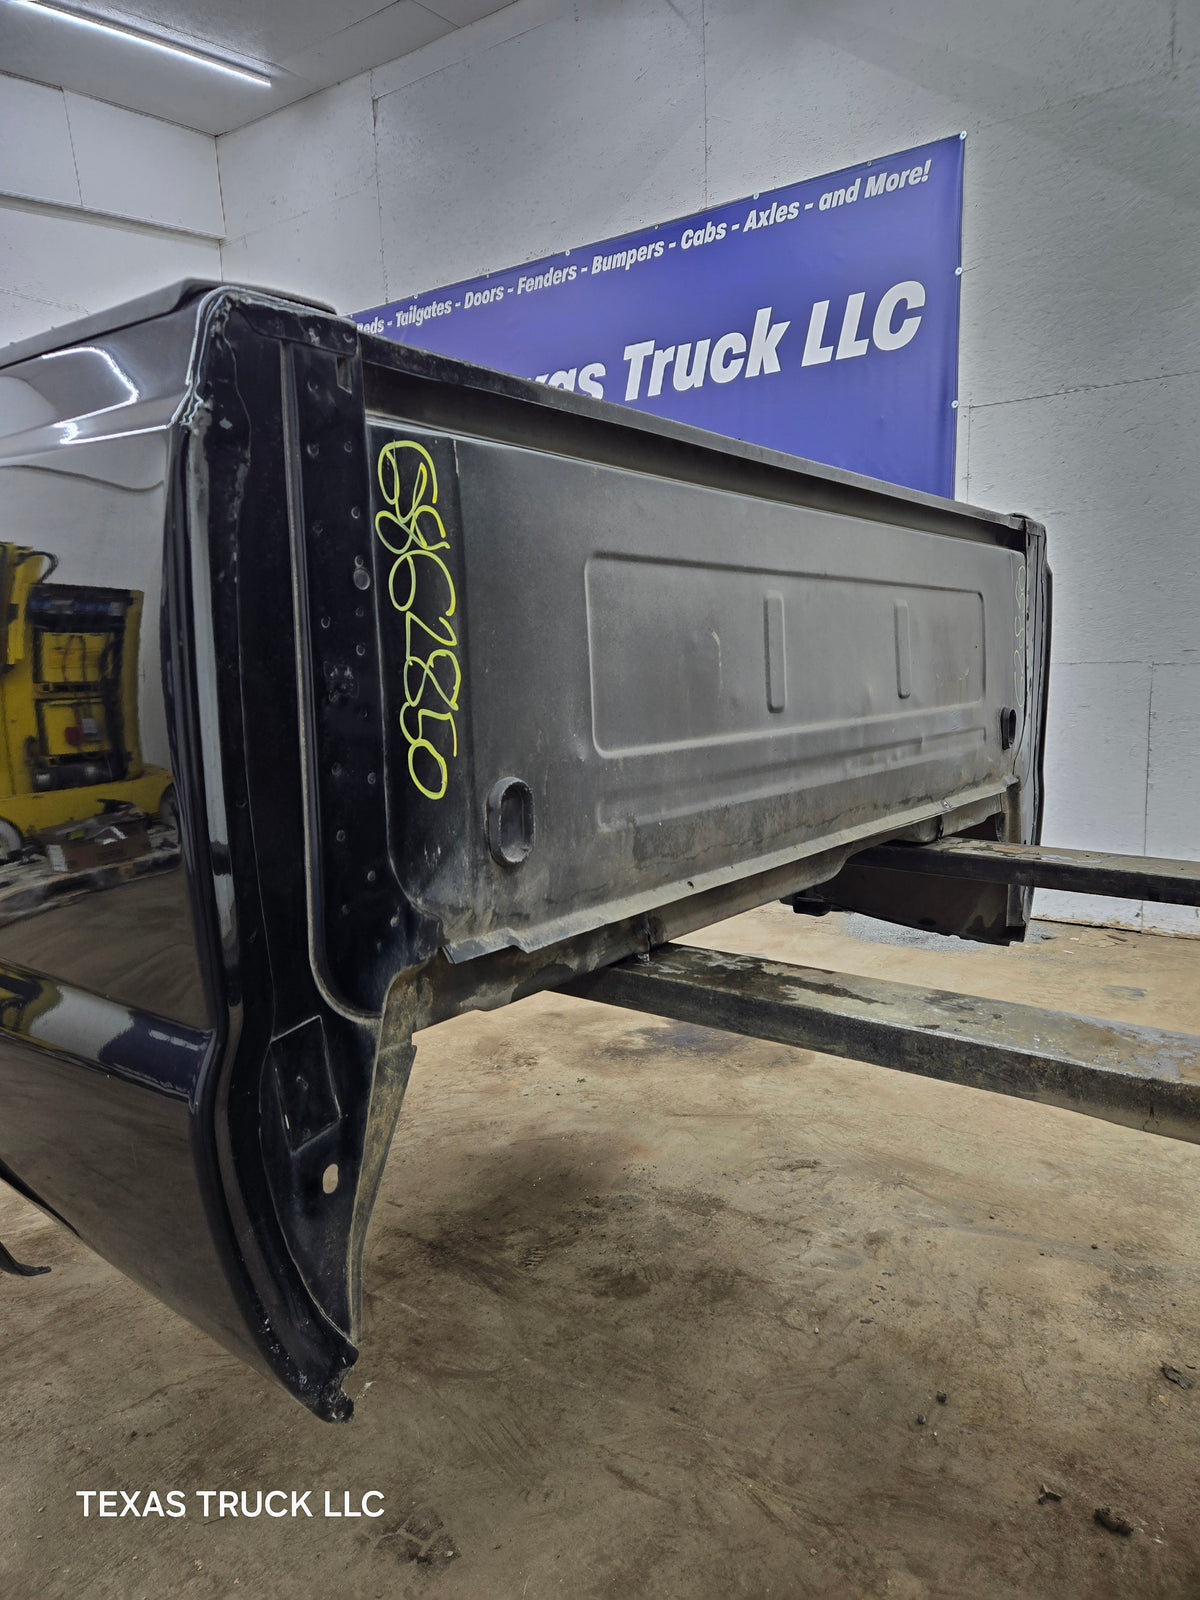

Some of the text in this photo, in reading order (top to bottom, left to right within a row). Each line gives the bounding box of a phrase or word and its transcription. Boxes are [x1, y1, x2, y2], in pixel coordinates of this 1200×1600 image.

[395, 299, 453, 328] Tailgates
[464, 286, 505, 309] Doors
[516, 265, 578, 295] Fenders
[591, 240, 665, 275] Bumpers
[680, 221, 728, 250] Cabs
[742, 201, 800, 233] Axles
[818, 177, 862, 212] and
[864, 158, 932, 199] More!
[623, 306, 791, 401] Truck
[800, 280, 926, 368] LLC
